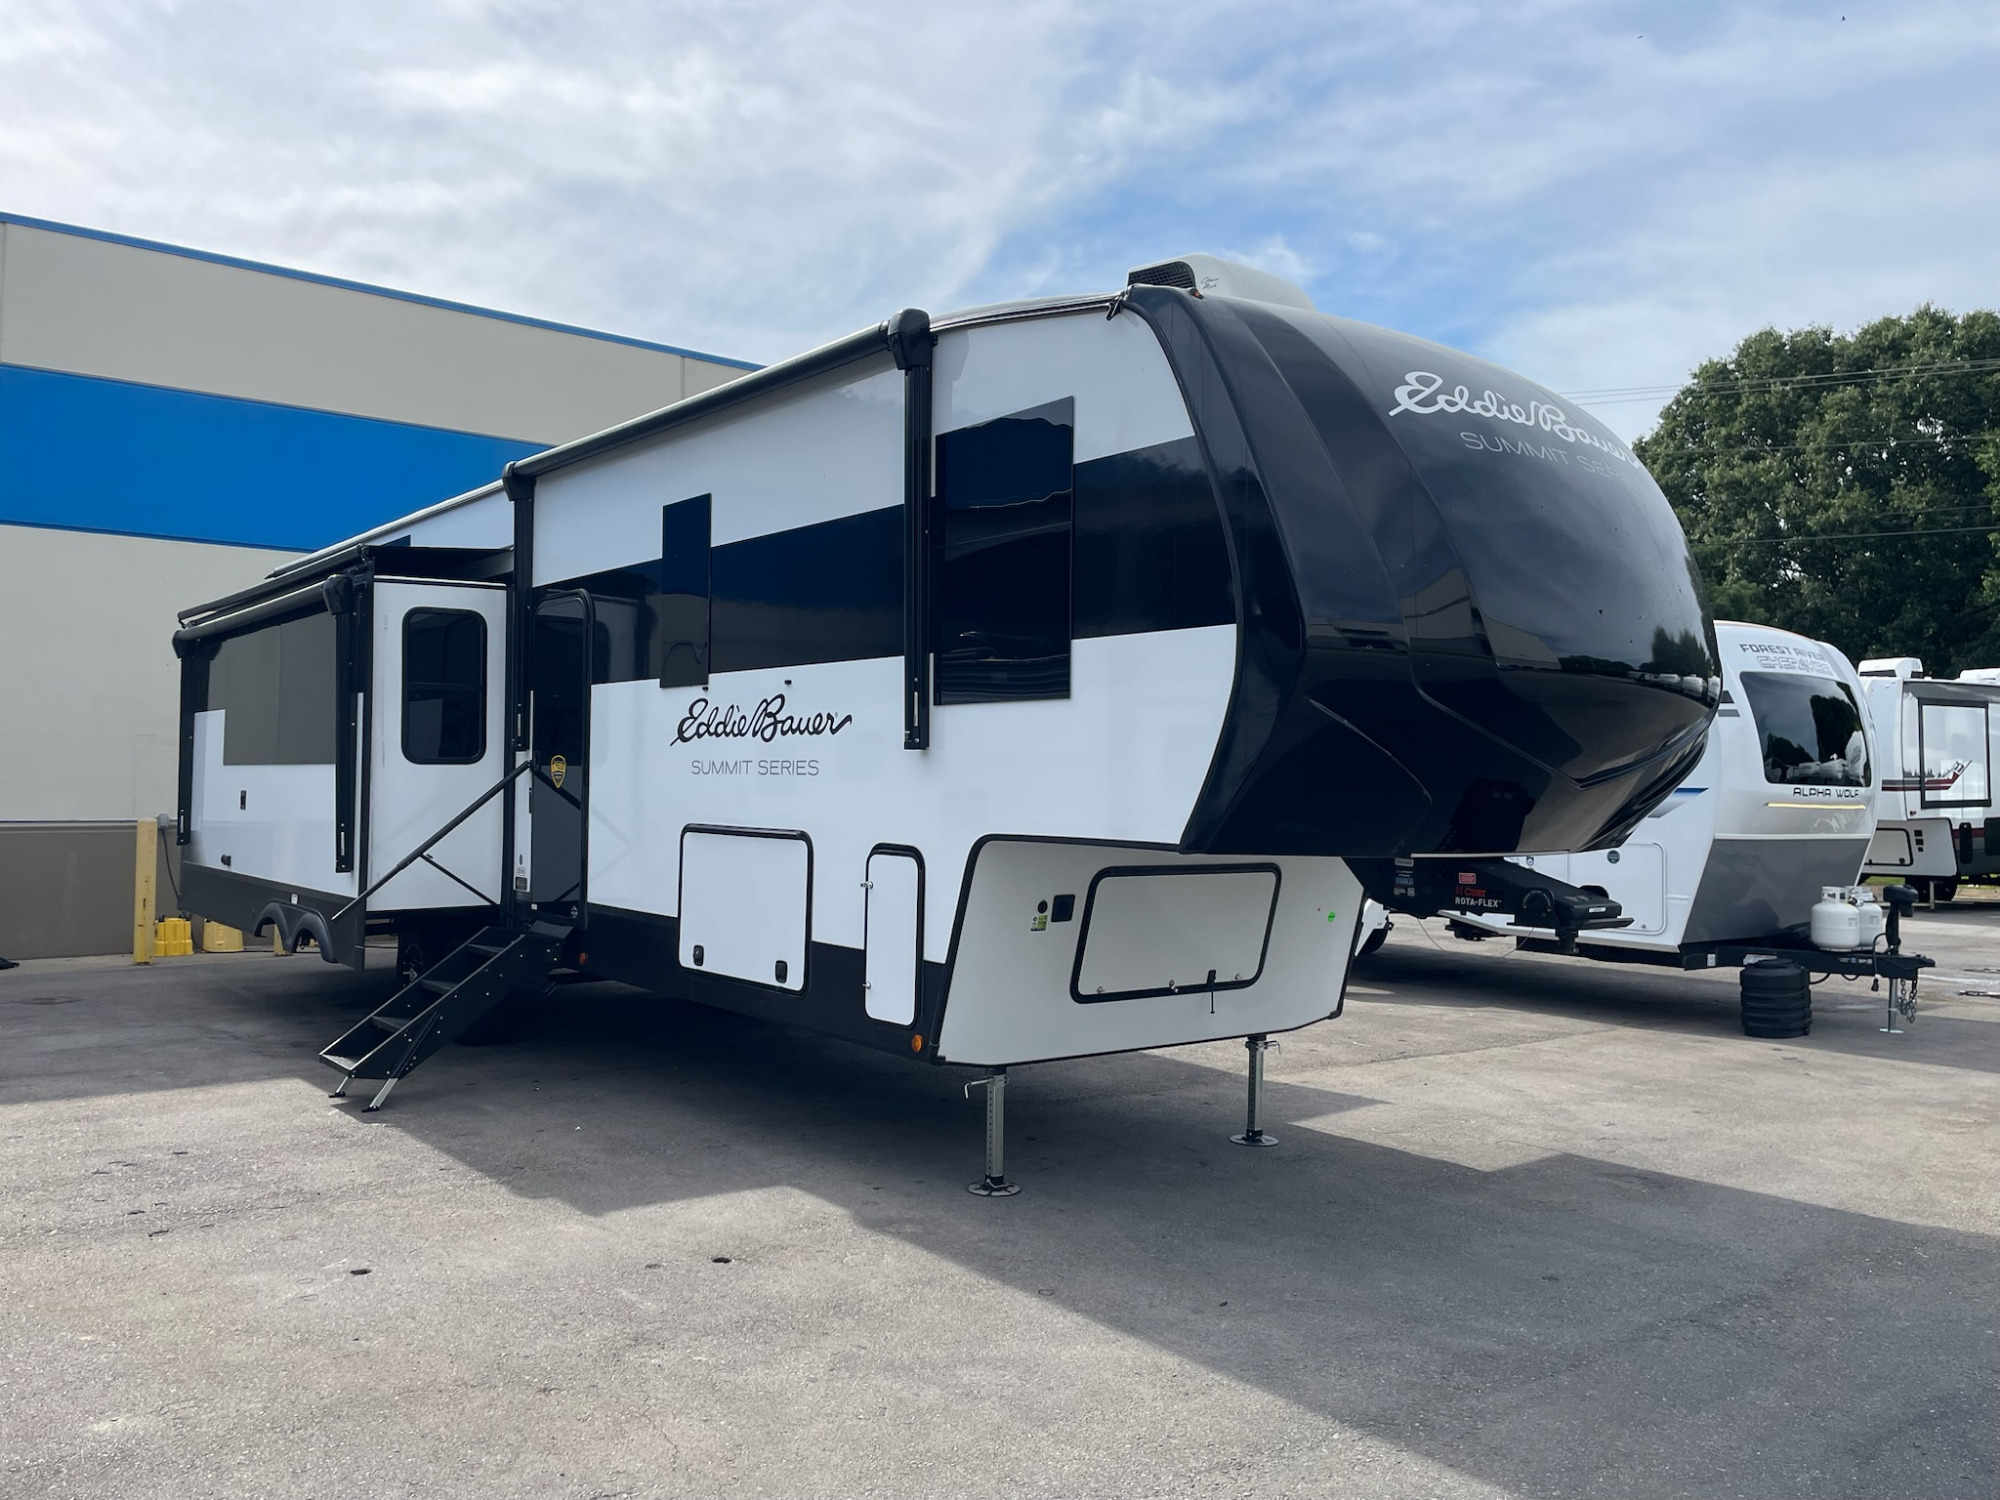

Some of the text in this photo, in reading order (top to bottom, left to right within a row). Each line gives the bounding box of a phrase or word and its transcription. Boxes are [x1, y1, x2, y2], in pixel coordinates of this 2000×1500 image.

[1388, 371, 1641, 469] Eddie Bauer
[1459, 431, 1569, 465] SUMMIT
[1738, 643, 1825, 661] FOREST RIVER
[670, 693, 852, 747] Eddie Bauer
[691, 759, 820, 776] SUMMIT SERIES
[1793, 787, 1859, 798] ALPHA WOLF
[1455, 896, 1499, 908] ROTA-FLEX
